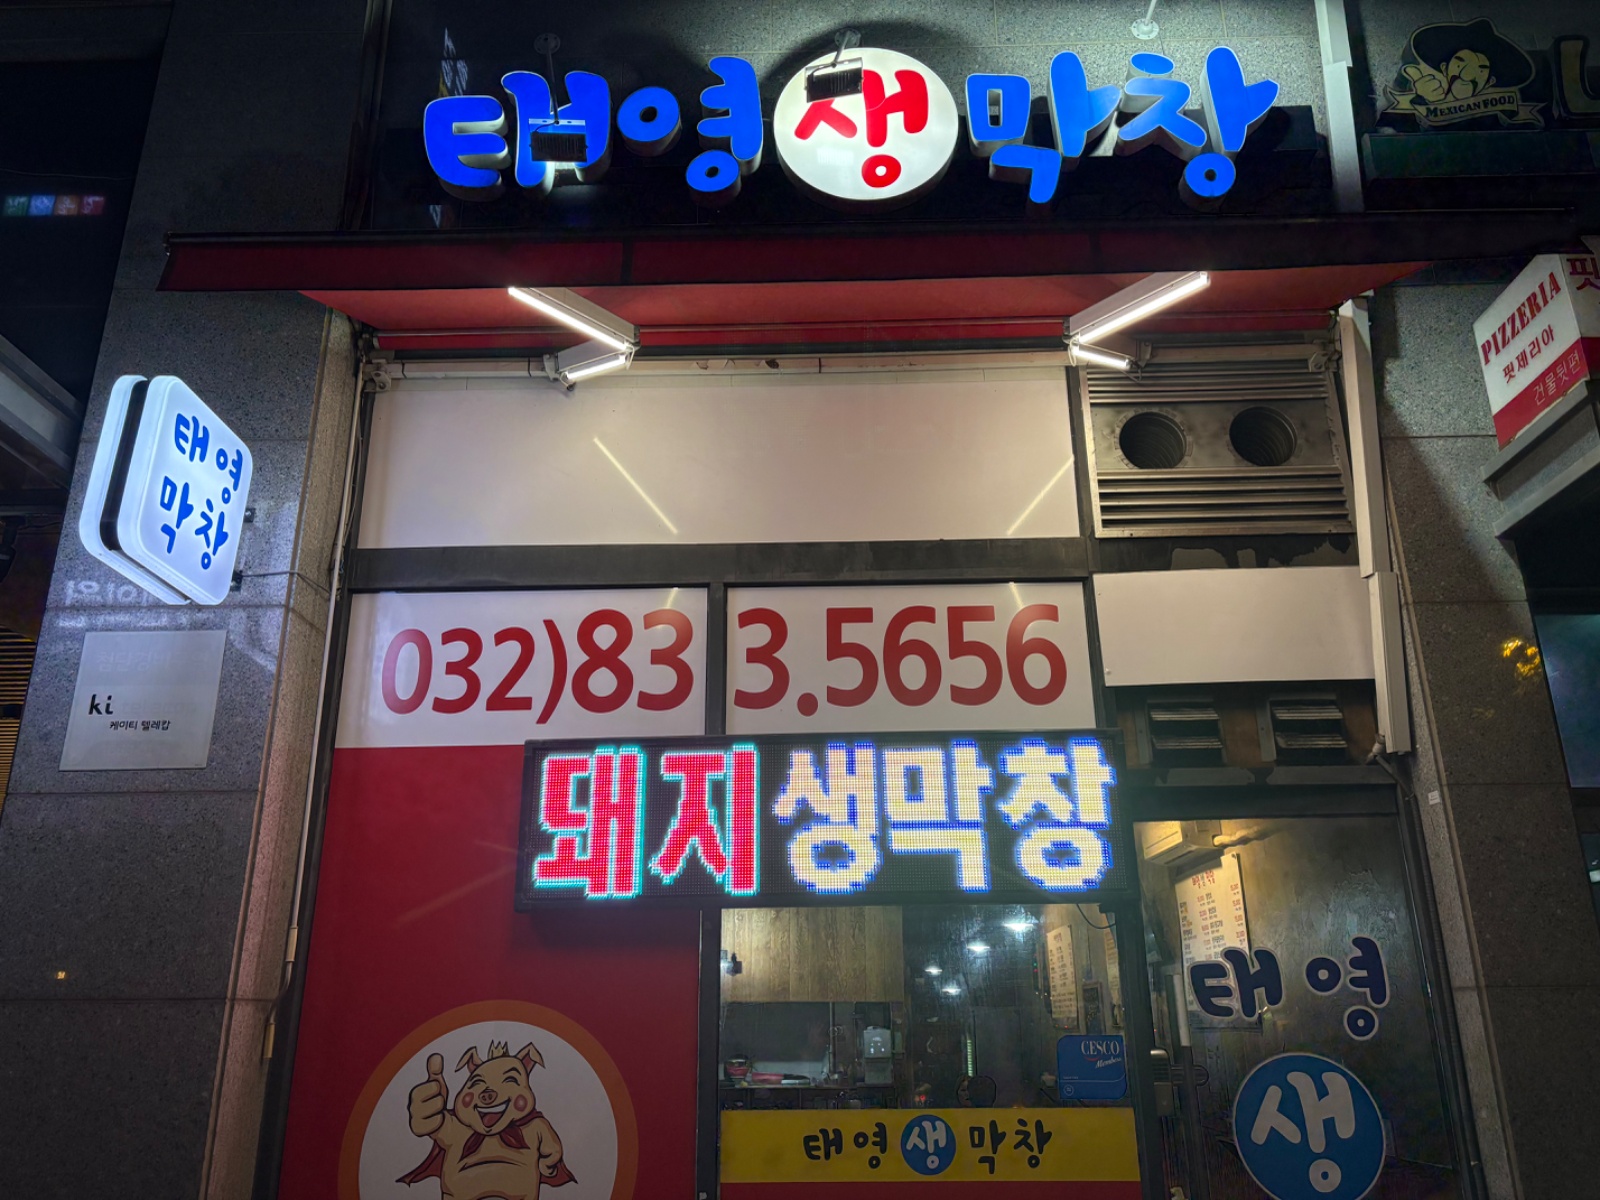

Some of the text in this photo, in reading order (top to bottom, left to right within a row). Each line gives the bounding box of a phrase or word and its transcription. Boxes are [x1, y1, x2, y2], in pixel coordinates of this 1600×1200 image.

[424, 56, 763, 193] 태영
[794, 69, 930, 189] 생
[966, 45, 1280, 204] 막창
[1483, 95, 1516, 110] FOOD
[1481, 272, 1562, 366] PIZZERIA
[1503, 324, 1555, 384] 핏제리아
[174, 412, 243, 505] 태영
[160, 475, 229, 570] 막창
[109, 720, 138, 731] 케이티
[1189, 935, 1389, 1041] 태영
[1081, 1040, 1120, 1055] CESCO
[803, 1118, 1052, 1174] 태영 생 막창
[1250, 1070, 1356, 1193] 생
